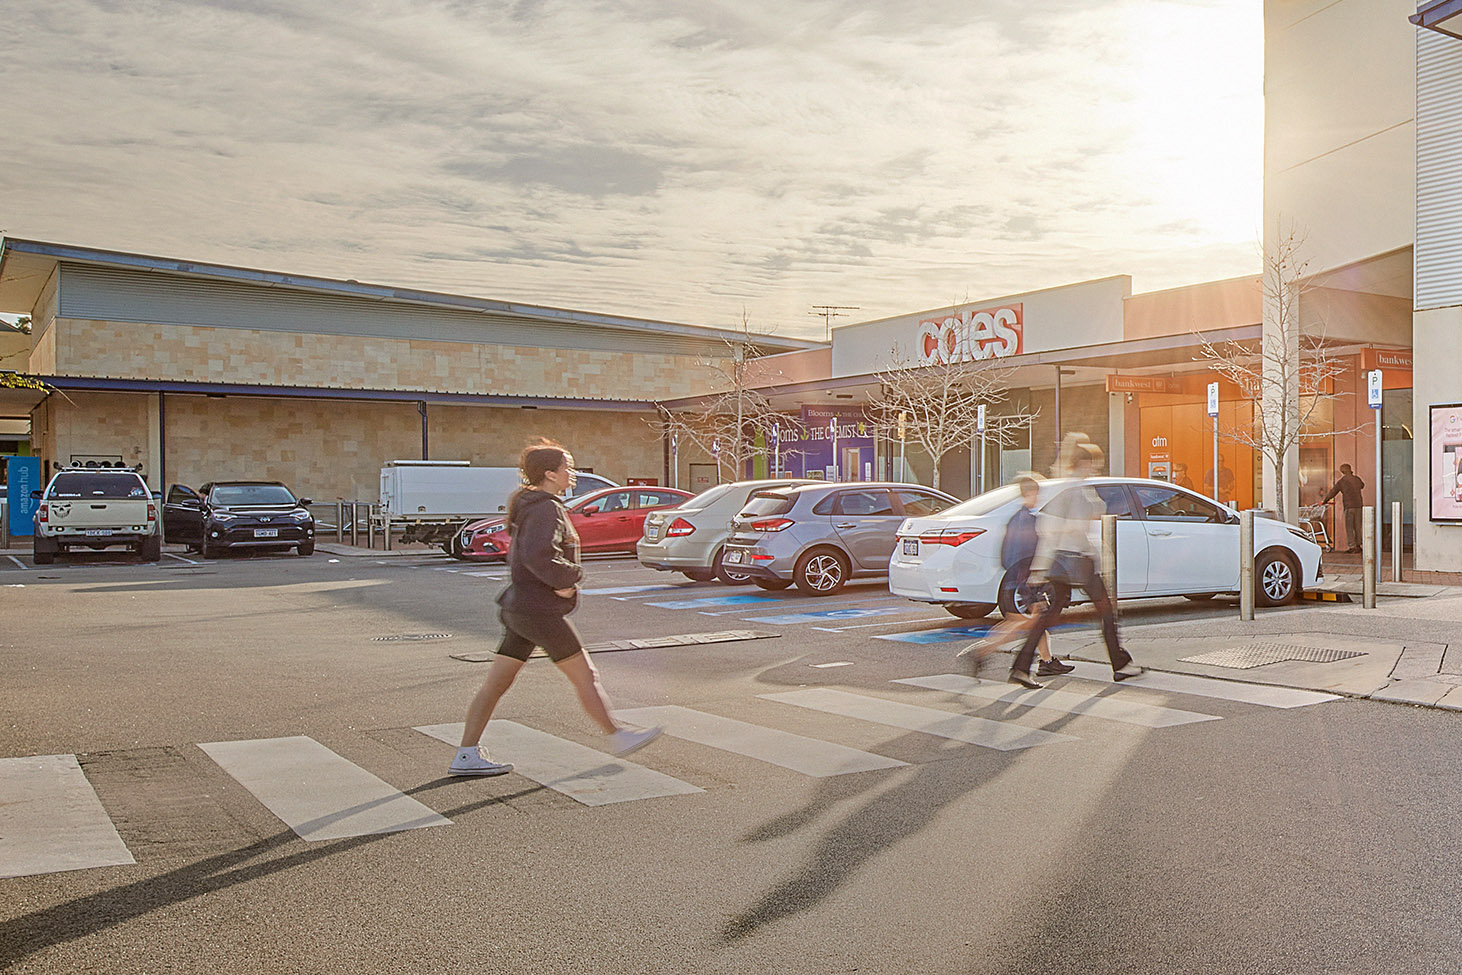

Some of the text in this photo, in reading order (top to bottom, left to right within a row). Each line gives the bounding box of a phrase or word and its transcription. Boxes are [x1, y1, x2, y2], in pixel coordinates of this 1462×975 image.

[916, 308, 1019, 367] coles
[825, 424, 857, 439] CEMIST
[1151, 435, 1167, 448] atm
[18, 466, 28, 514] amazon hub
